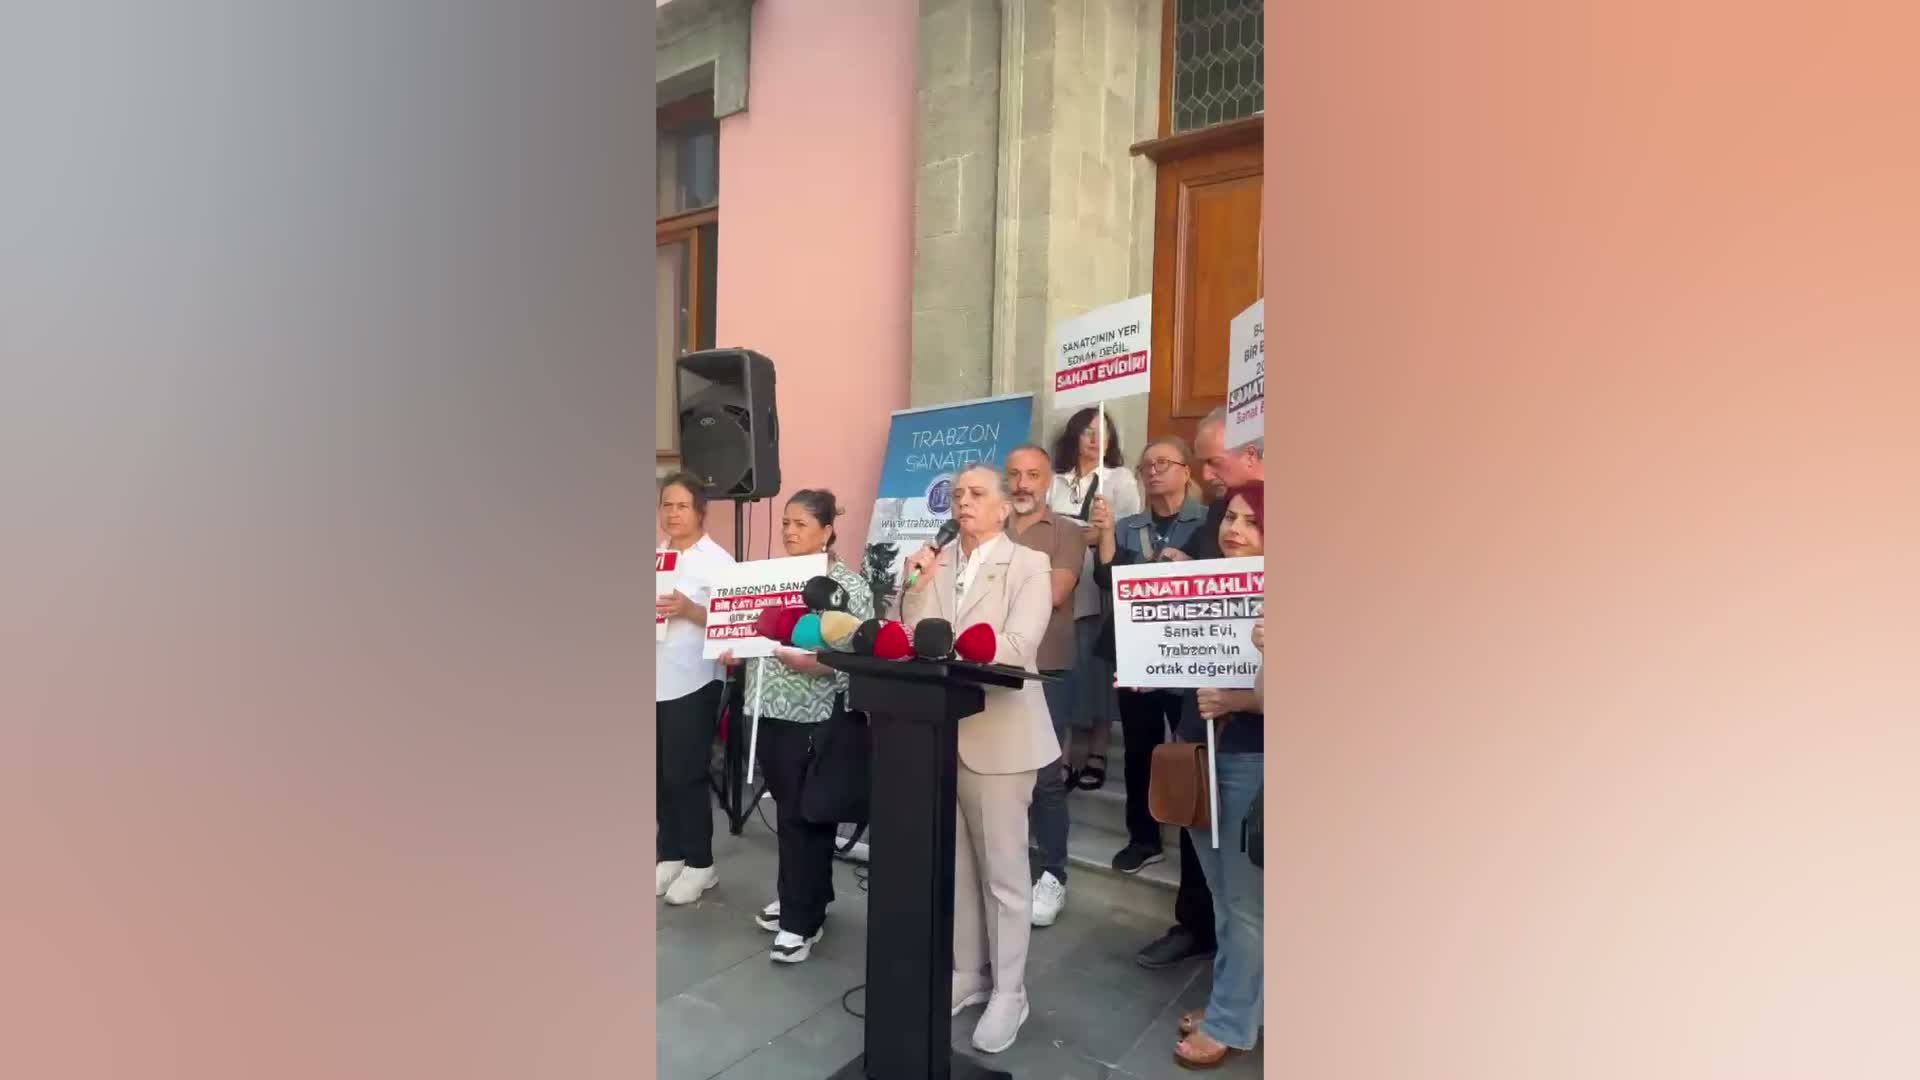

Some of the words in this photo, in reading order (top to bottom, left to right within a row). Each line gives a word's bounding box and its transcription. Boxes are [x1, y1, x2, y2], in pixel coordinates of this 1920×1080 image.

[1057, 367, 1096, 388] SANAT
[911, 423, 1001, 449] TRABZON
[1120, 580, 1189, 599] SANATI
[1164, 626, 1205, 638] Sanat
[1209, 623, 1237, 638] Evi,
[1146, 663, 1183, 675] ortak
